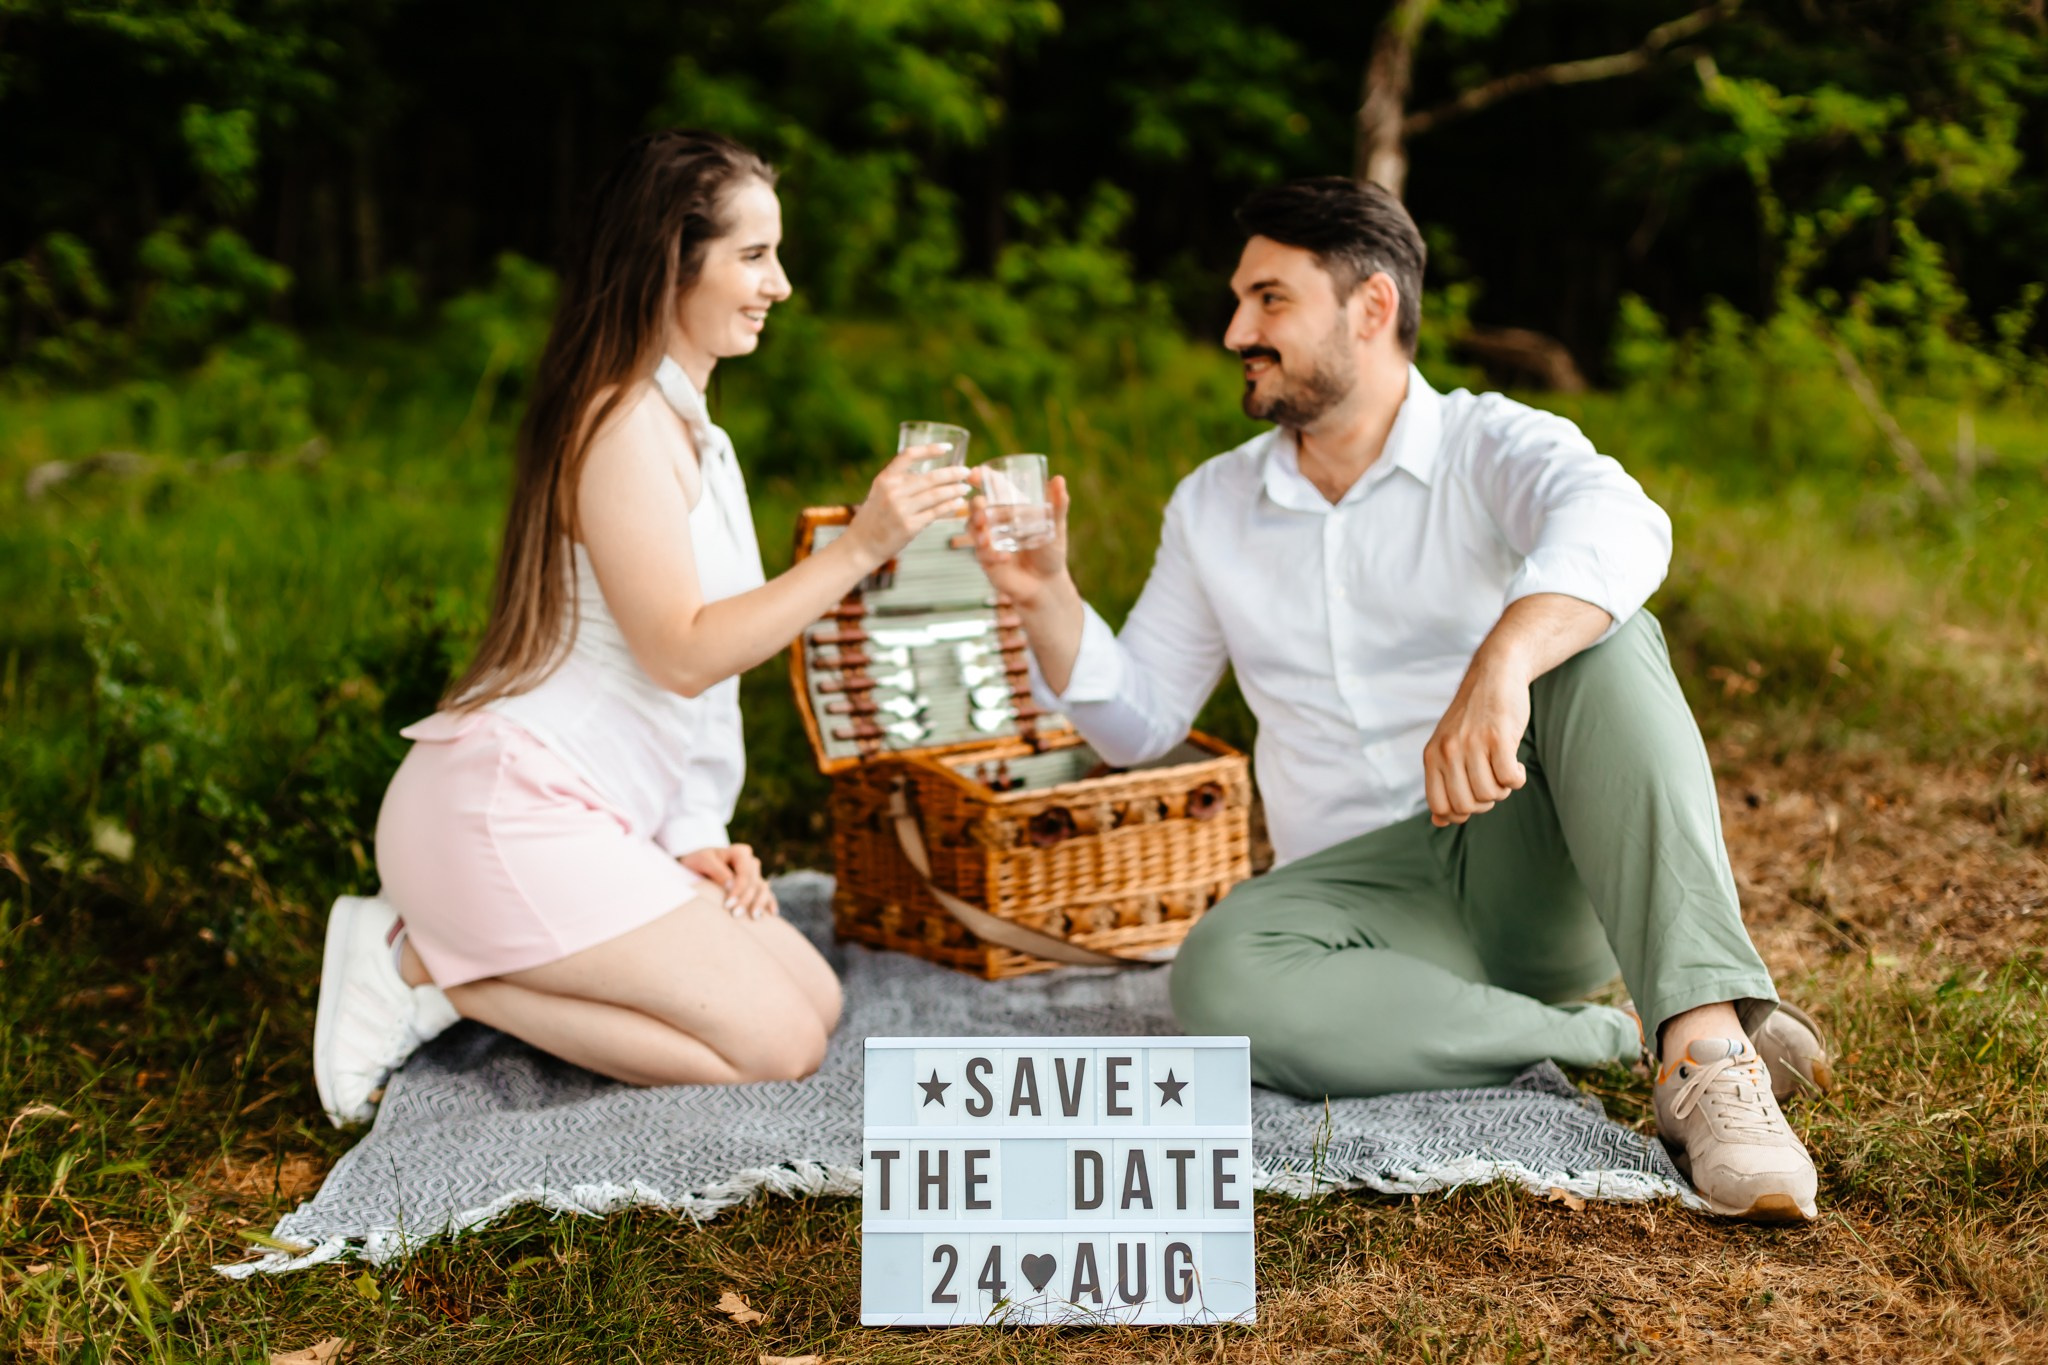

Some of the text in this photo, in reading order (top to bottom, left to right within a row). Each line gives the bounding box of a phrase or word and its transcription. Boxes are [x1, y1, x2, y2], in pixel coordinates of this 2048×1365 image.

[966, 1057, 1133, 1117] SAVE
[871, 1149, 1240, 1210] THE DATE
[931, 1242, 1194, 1305] 24 AUG
